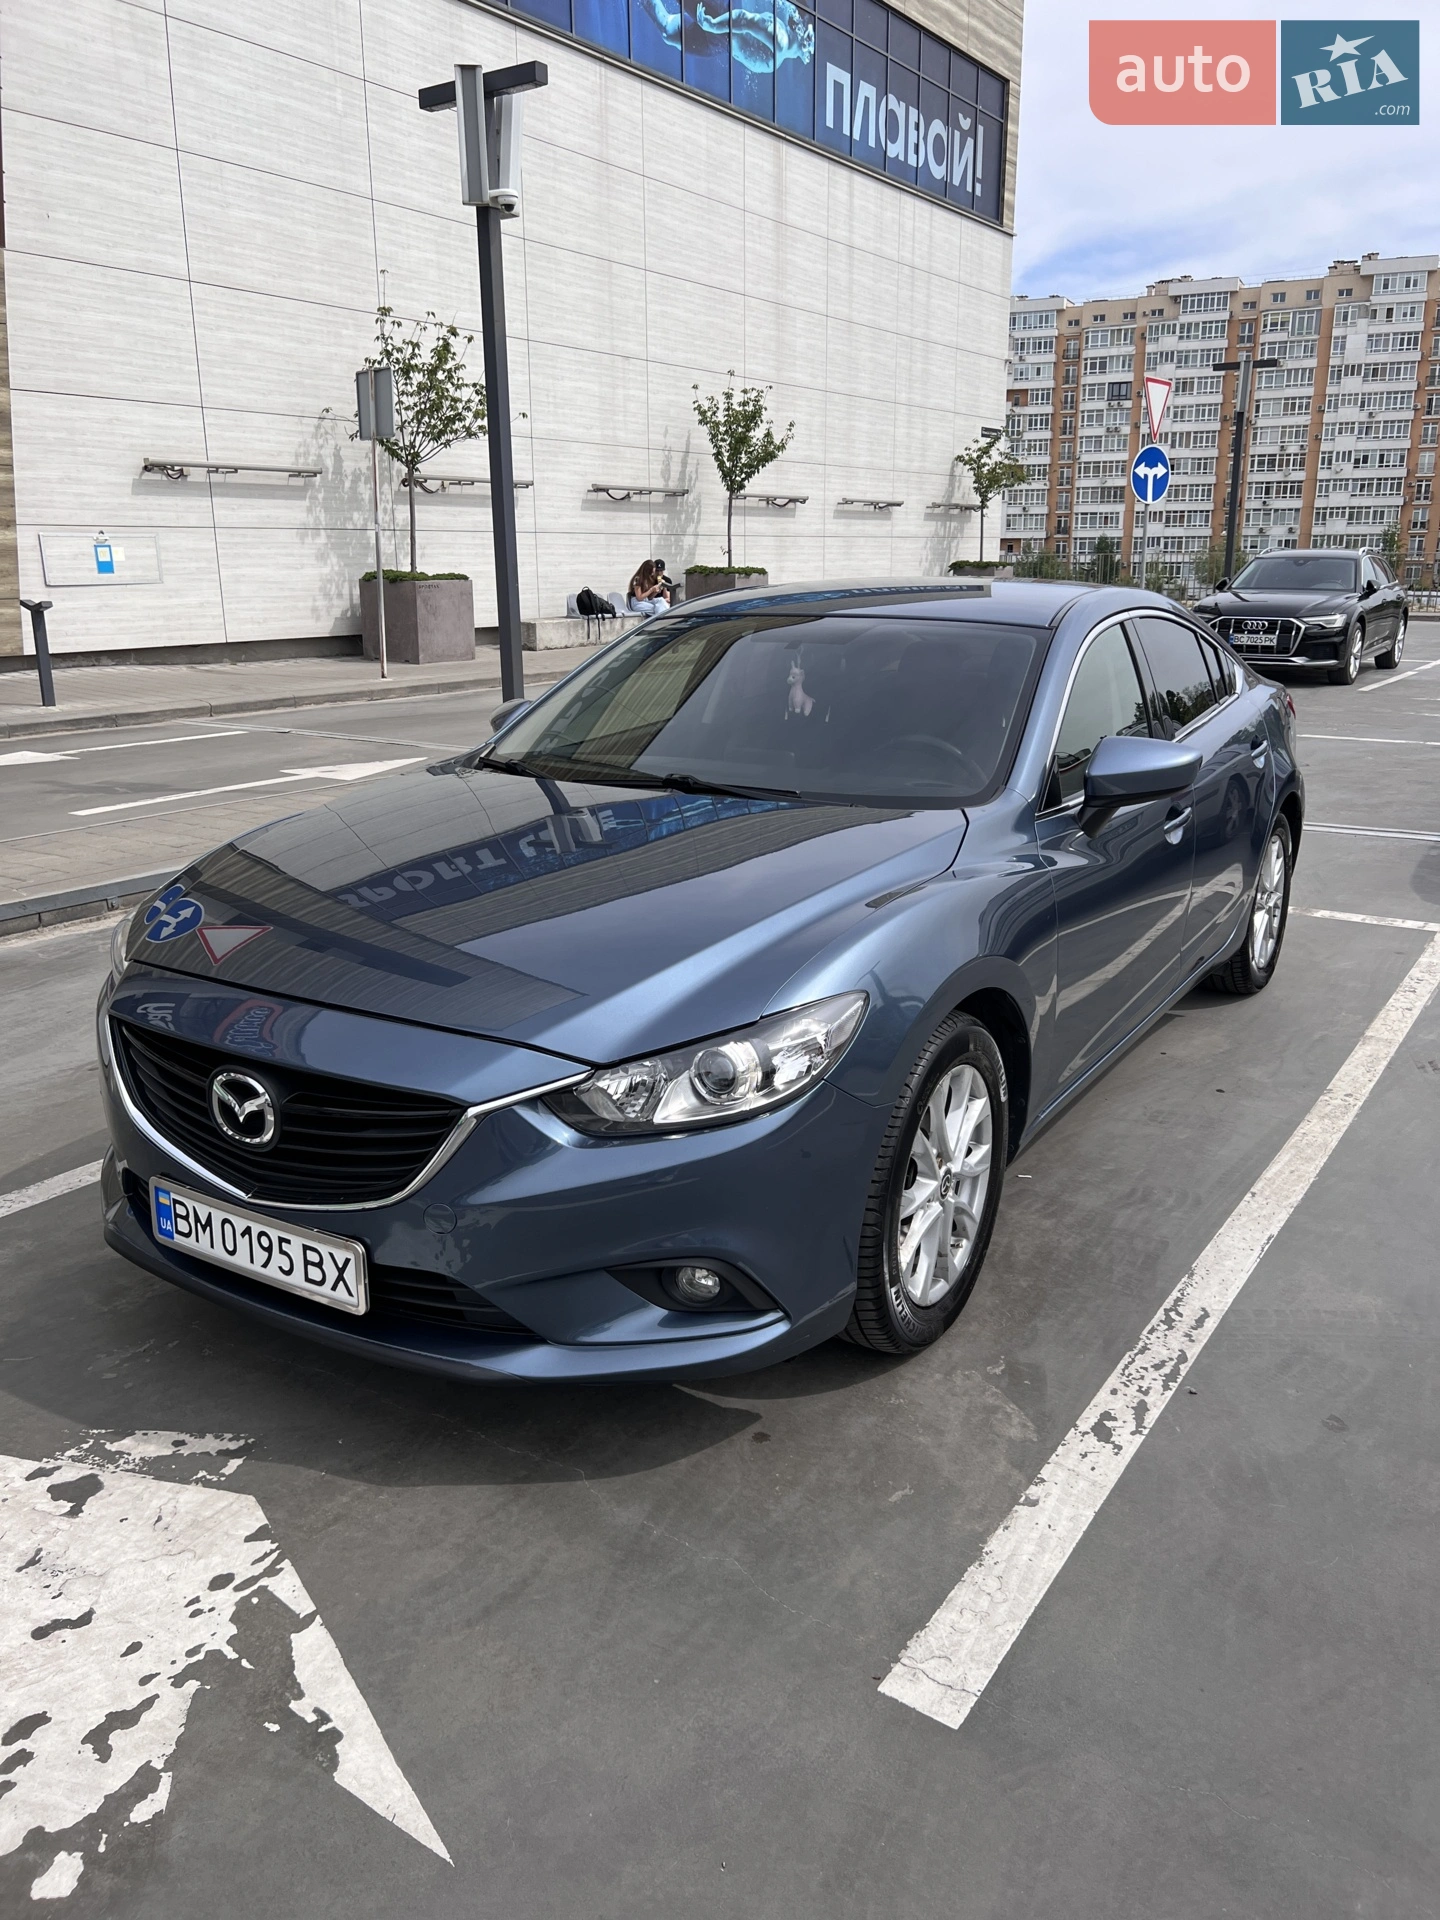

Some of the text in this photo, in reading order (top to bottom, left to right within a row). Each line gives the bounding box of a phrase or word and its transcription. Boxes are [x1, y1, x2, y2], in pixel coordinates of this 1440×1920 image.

[1246, 636, 1264, 644] 7025
[1264, 636, 1276, 645] PK
[160, 1216, 173, 1232] UA
[172, 1197, 355, 1299] BM 0195 BX
